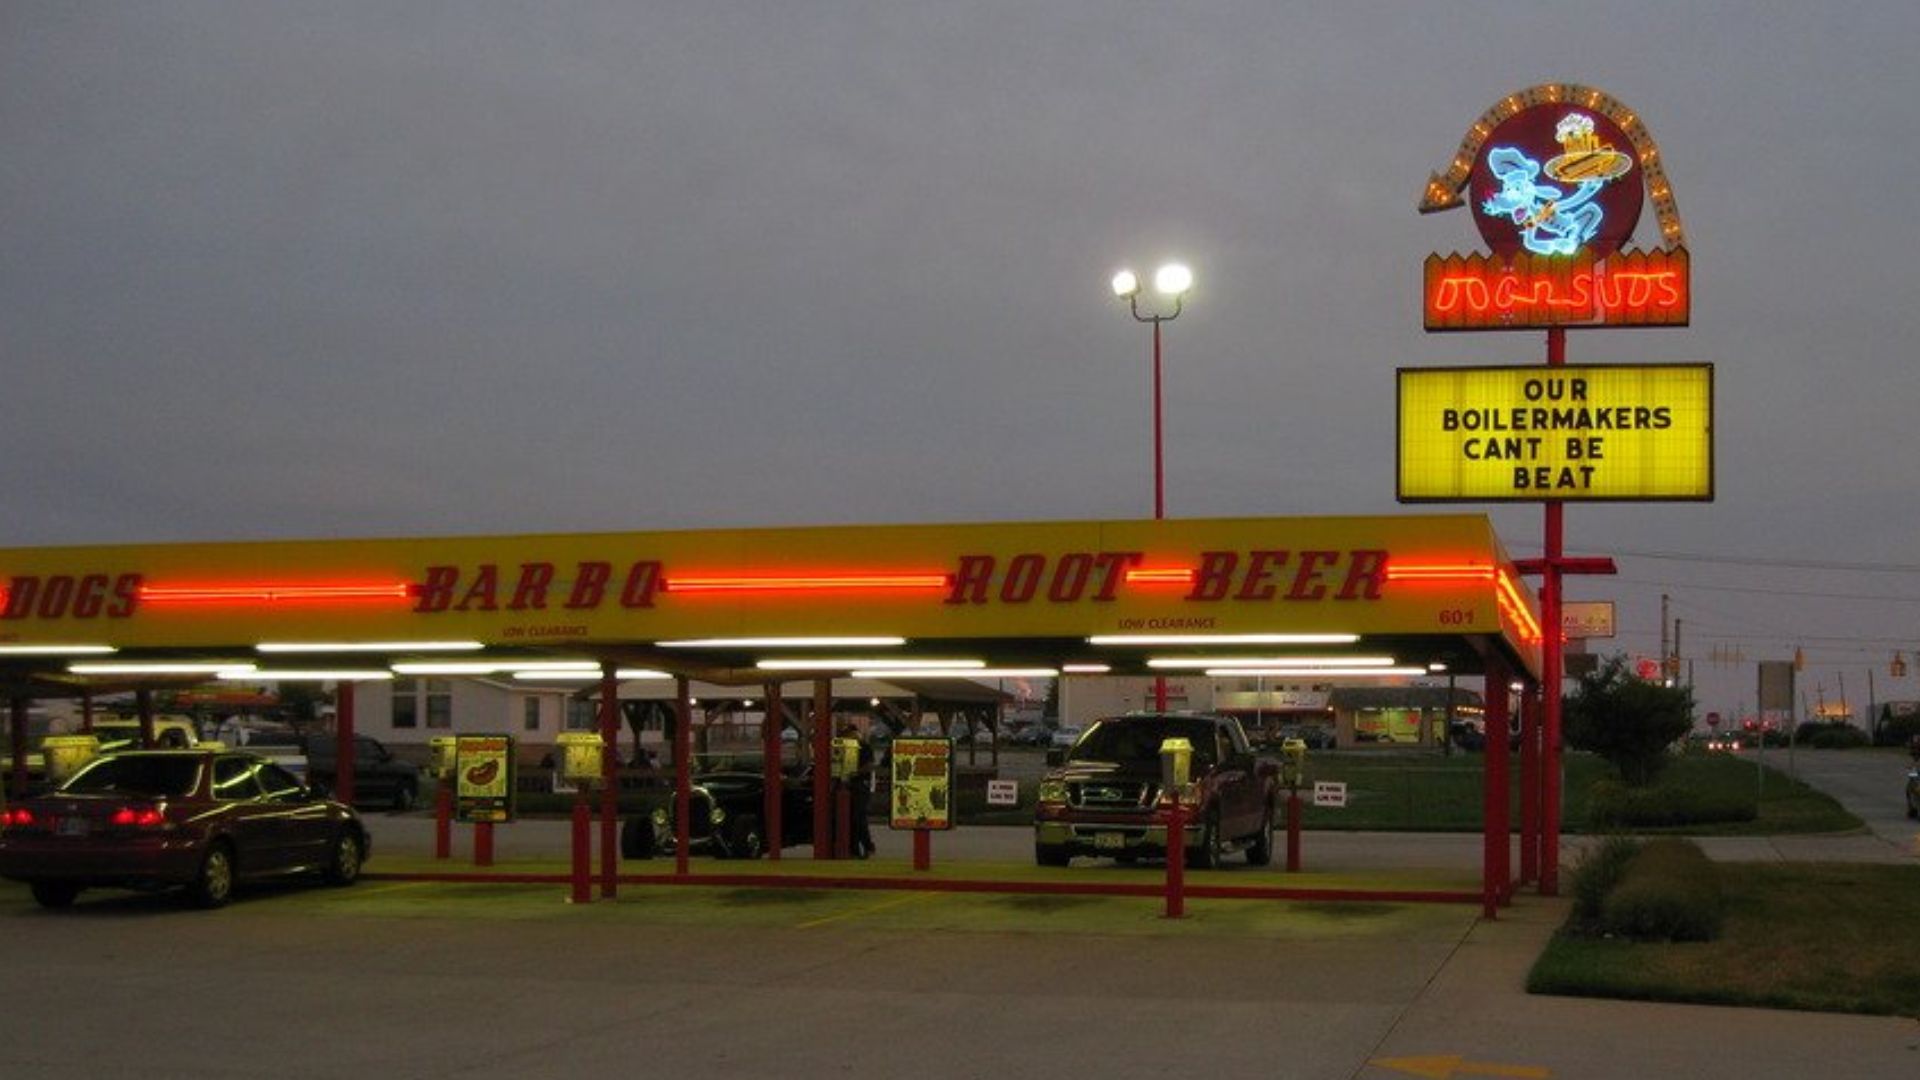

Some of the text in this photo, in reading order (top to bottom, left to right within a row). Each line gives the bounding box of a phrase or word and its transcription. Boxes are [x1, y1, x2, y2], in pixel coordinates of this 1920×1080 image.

[1524, 378, 1588, 400] OUR
[1443, 407, 1671, 431] BOILERMAKERS
[1463, 437, 1604, 460] CANT BE
[1513, 466, 1596, 489] BEAT
[944, 549, 1389, 604] ROOT BEER
[0, 573, 143, 618] DOGS
[1119, 617, 1216, 630] LOW CLEARANCE
[1439, 609, 1474, 625] 601
[503, 625, 588, 638] LOW CLEARANCE
